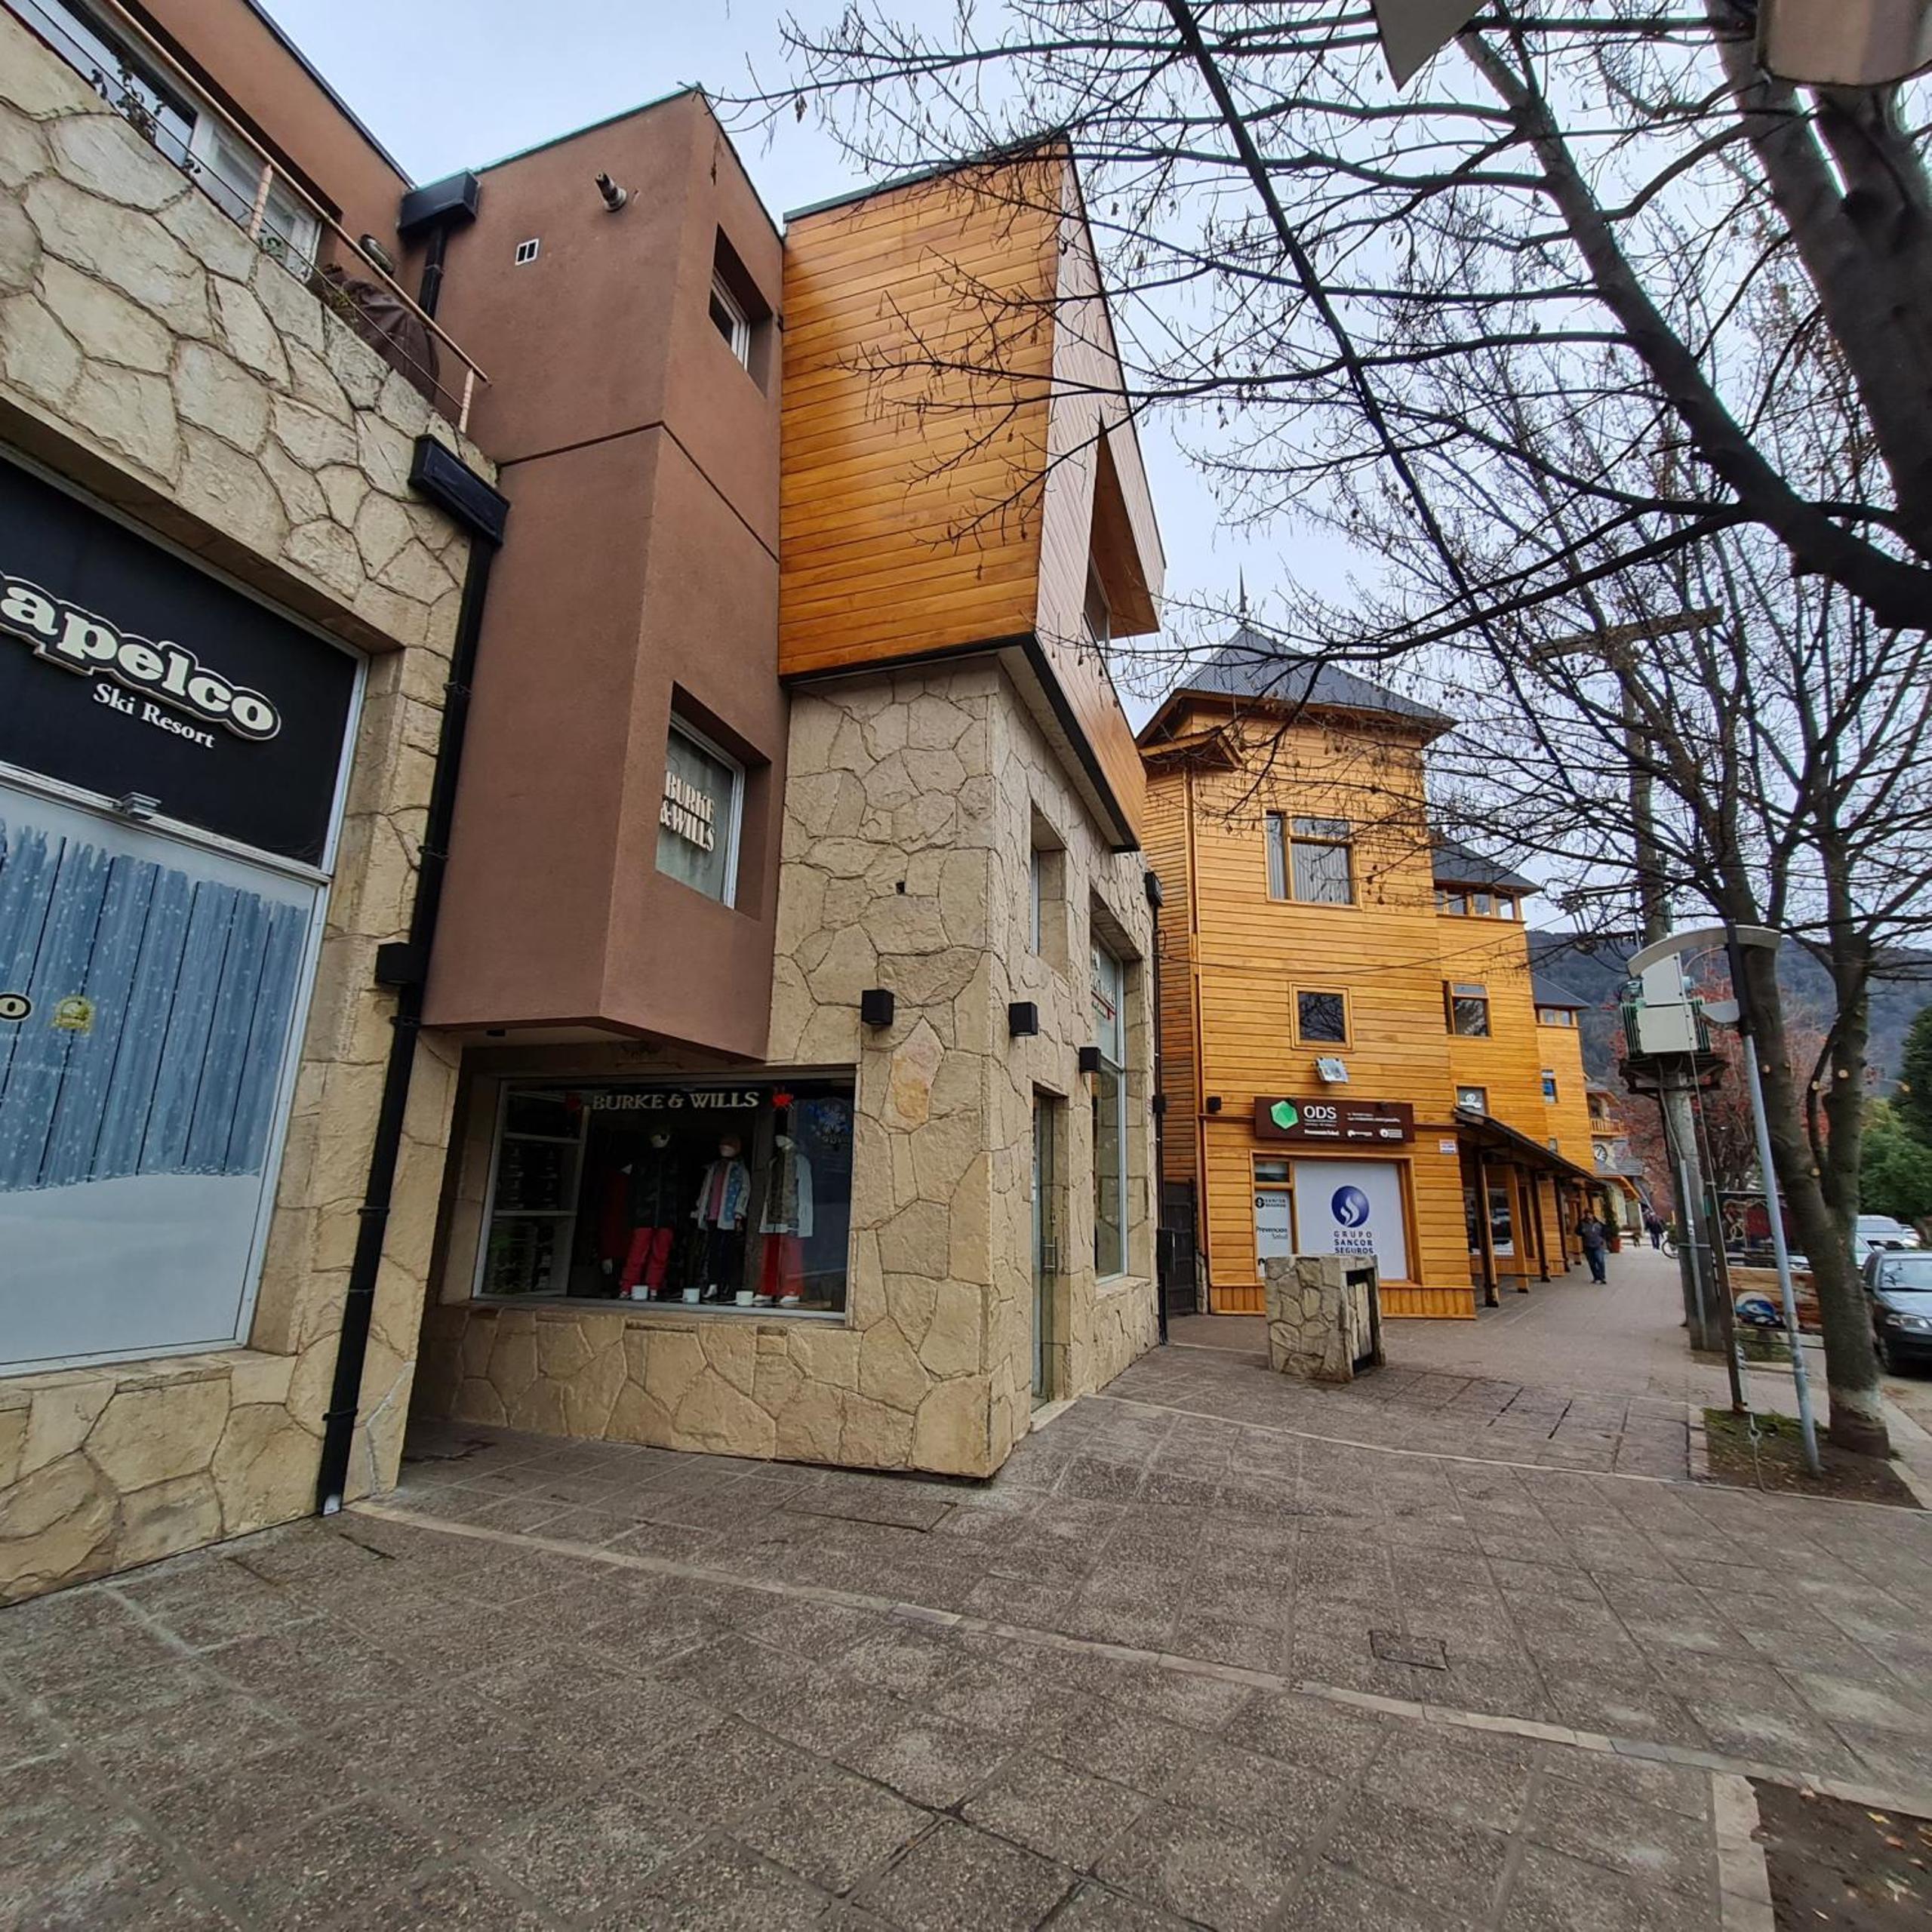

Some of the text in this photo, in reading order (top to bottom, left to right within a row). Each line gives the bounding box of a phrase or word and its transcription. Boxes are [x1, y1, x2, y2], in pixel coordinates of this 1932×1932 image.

[93, 683, 215, 749] Ski Resort
[660, 800, 715, 852] & WILLS
[592, 1091, 760, 1110] BURKE & WILLS
[1303, 1106, 1337, 1119] ODS
